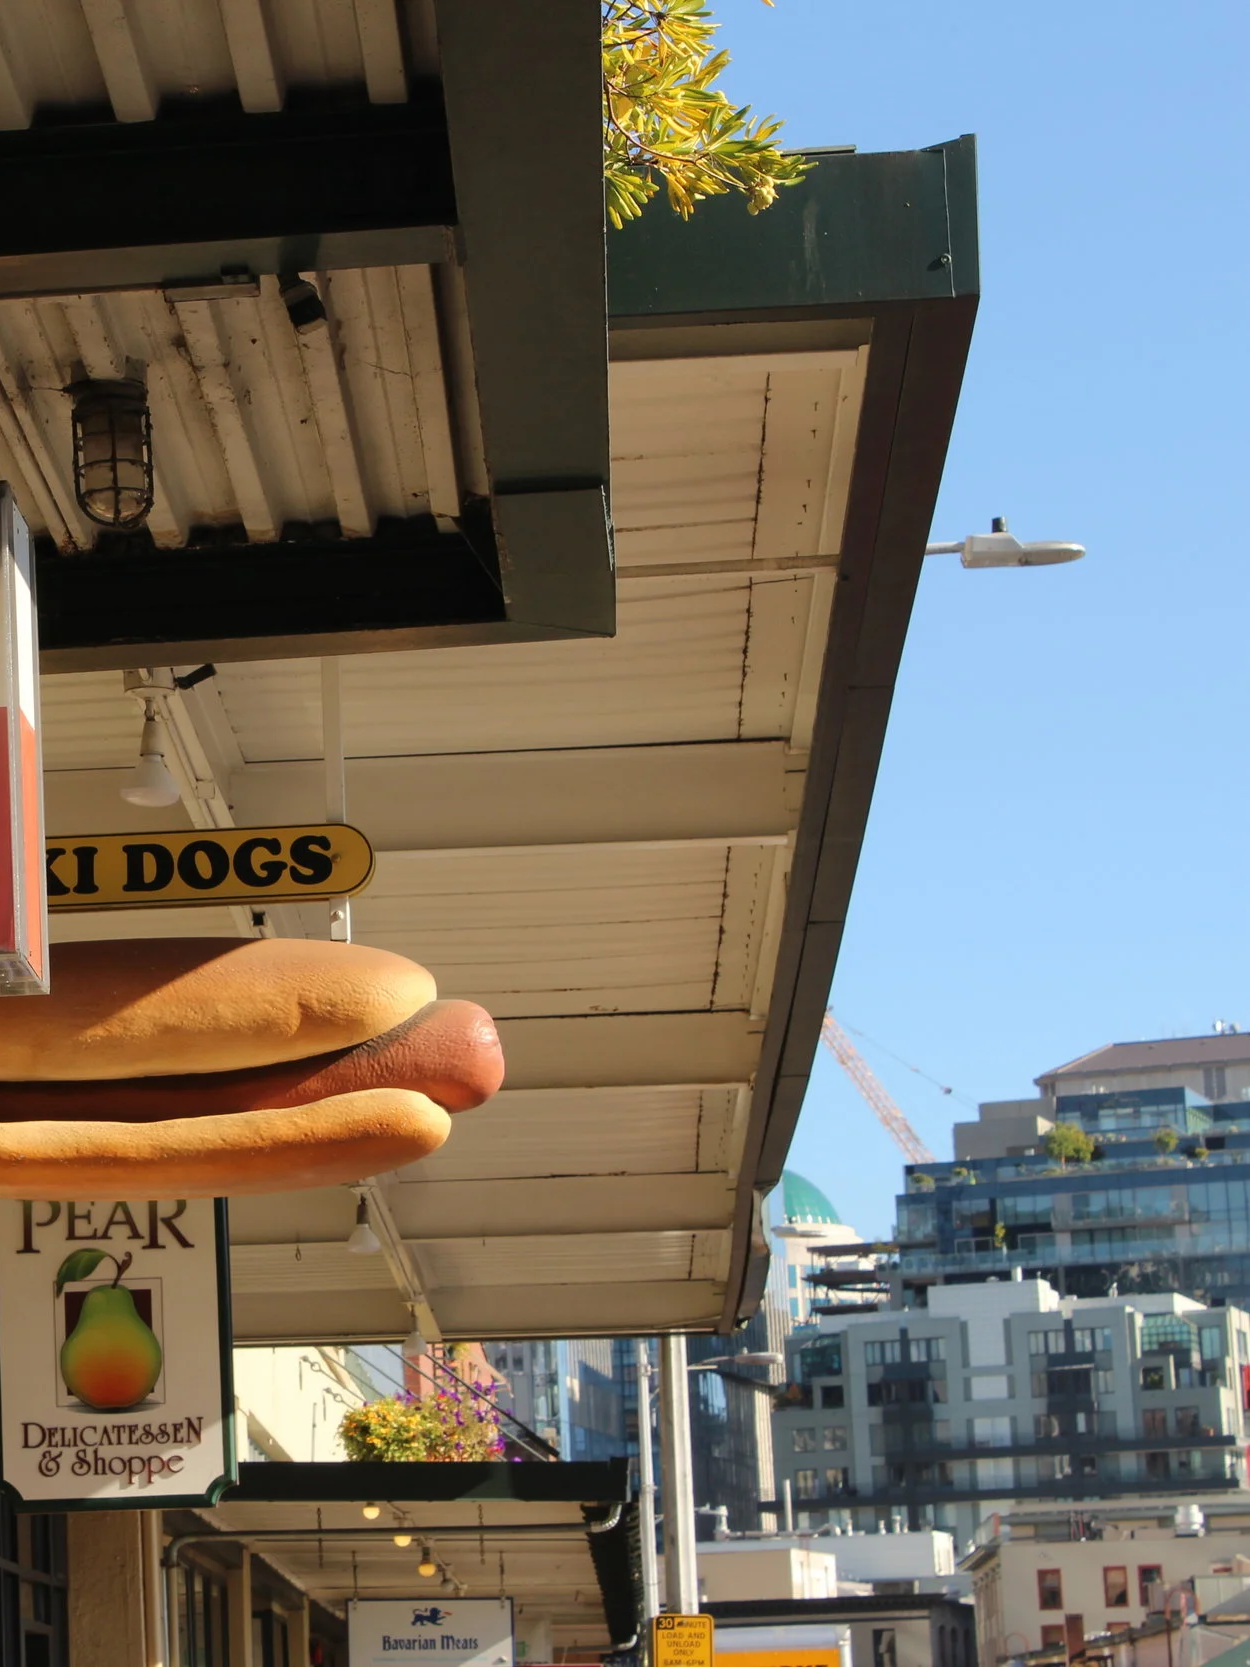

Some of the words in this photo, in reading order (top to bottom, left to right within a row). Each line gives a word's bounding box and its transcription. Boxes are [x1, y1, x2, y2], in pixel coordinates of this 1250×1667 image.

[122, 835, 333, 892] DOGS
[16, 1199, 195, 1254] PEAR
[21, 1416, 204, 1449] DELICATESSEN
[38, 1450, 63, 1477] &
[71, 1448, 184, 1485] Shoppe
[658, 1618, 673, 1628] 30
[382, 1634, 436, 1651] Bavarian
[440, 1634, 479, 1650] Meats
